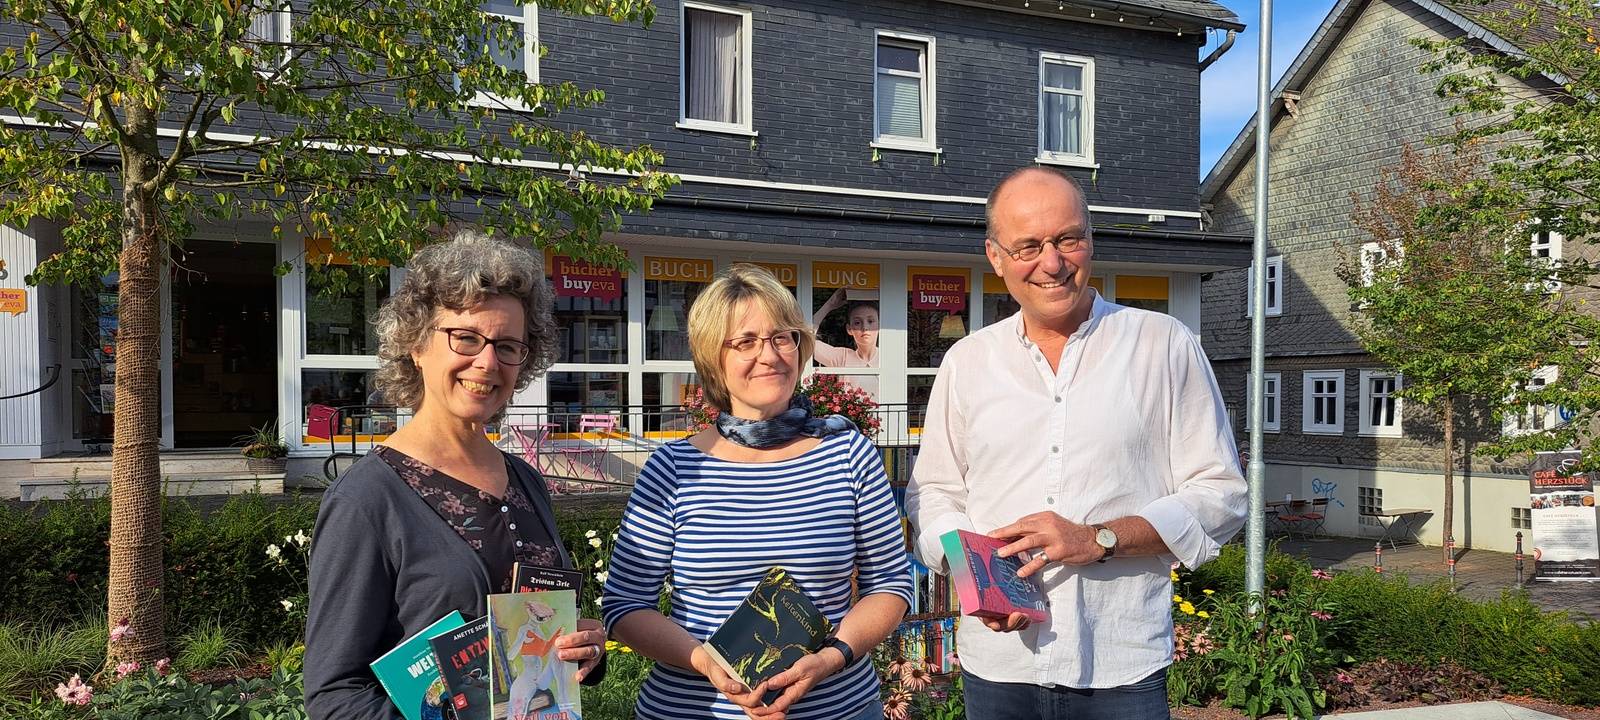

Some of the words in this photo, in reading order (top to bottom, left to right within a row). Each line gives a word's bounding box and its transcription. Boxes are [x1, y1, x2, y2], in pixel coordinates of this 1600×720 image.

[559, 261, 615, 277] bücher
[651, 260, 708, 279] BUCH
[815, 269, 868, 286] LUNG
[562, 275, 616, 294] buyeva
[918, 279, 961, 292] bücher
[920, 291, 961, 307] buyeva
[530, 576, 555, 586] Tristan
[556, 579, 570, 588] Irle
[453, 627, 475, 641] ANETTE
